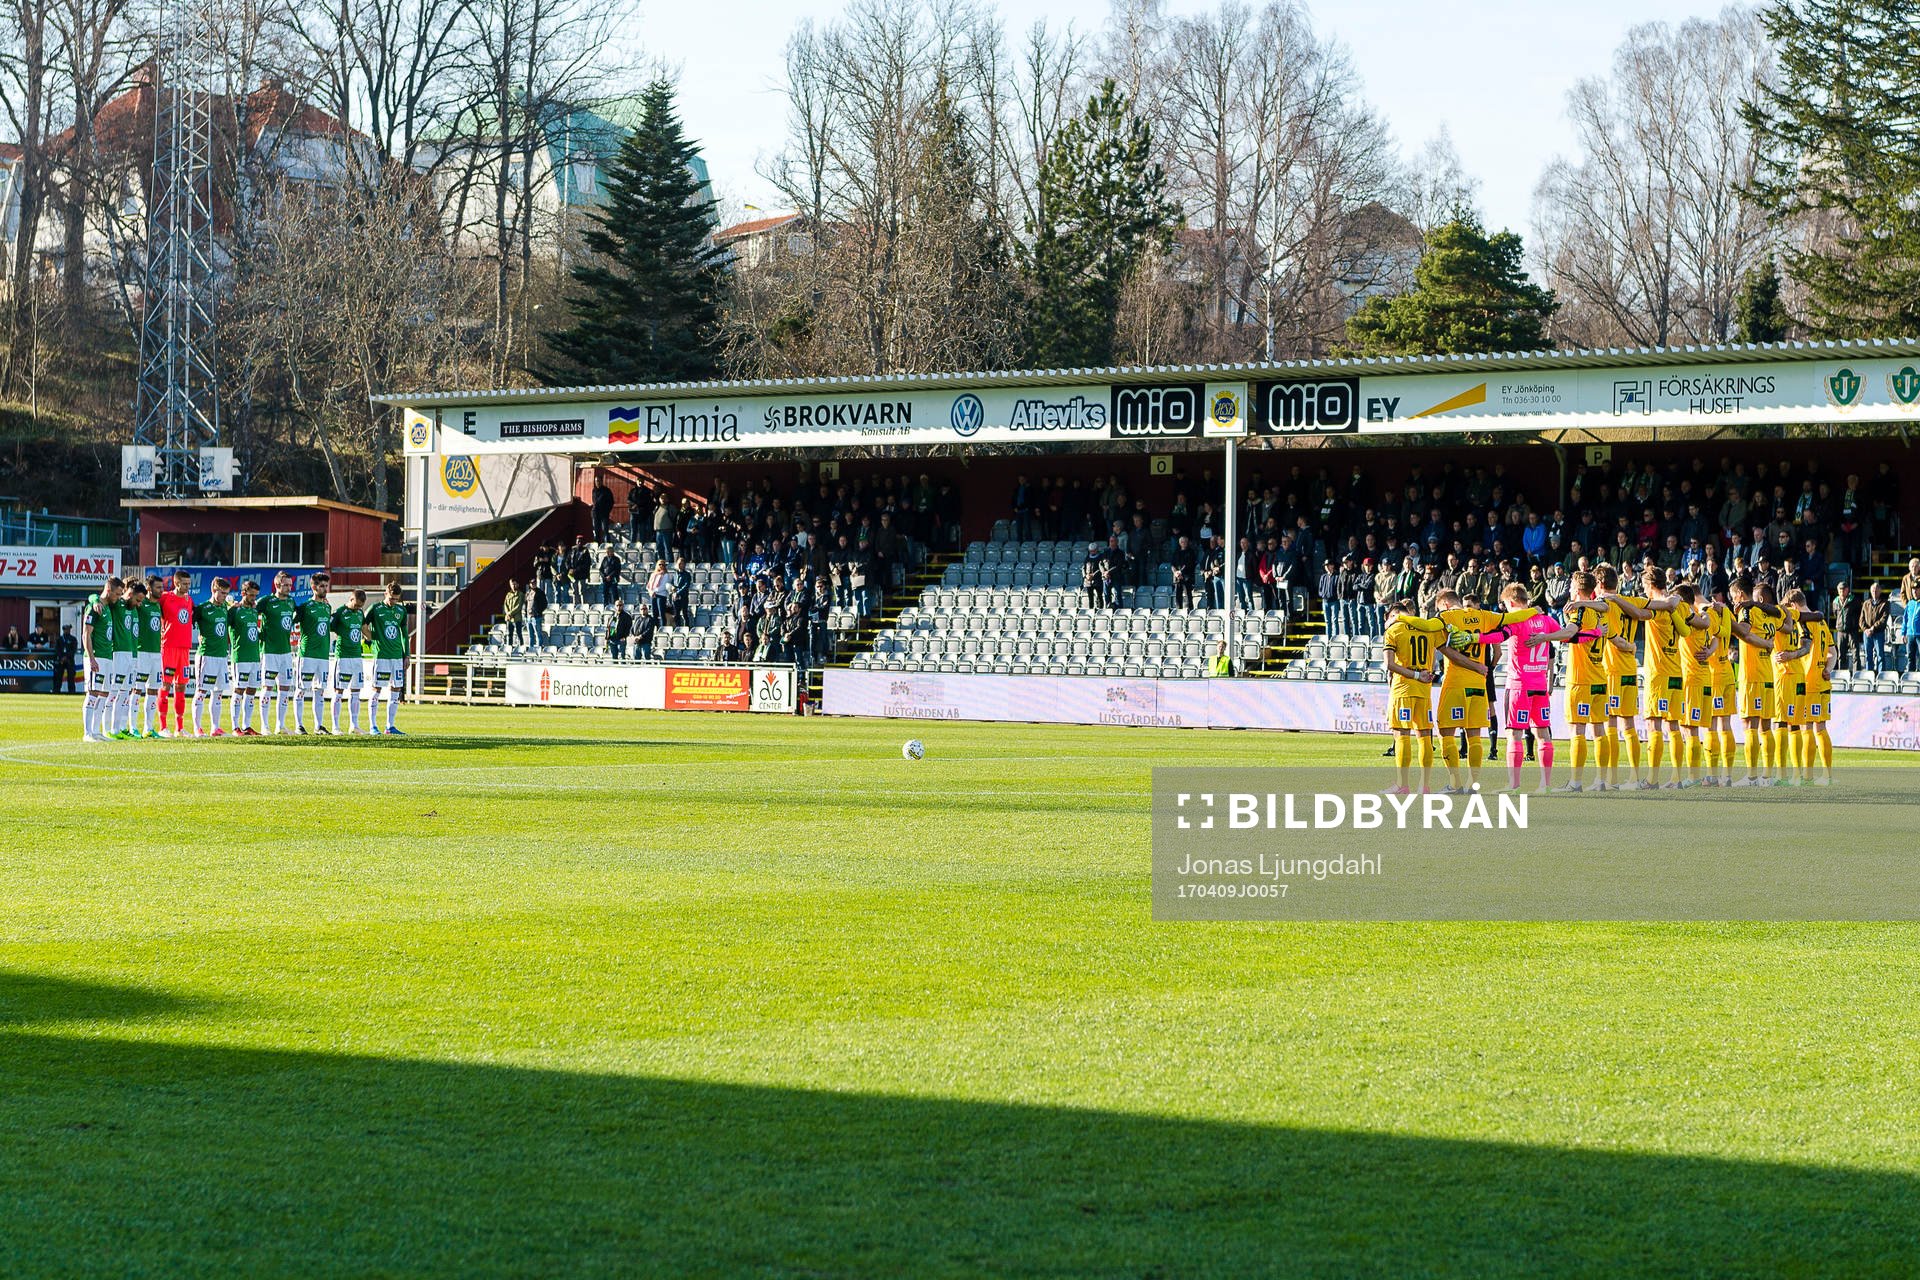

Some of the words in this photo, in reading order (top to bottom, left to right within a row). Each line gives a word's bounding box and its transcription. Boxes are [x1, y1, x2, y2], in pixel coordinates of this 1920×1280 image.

[1502, 385, 1513, 394] EY
[1514, 384, 1555, 395] Jönköping
[1659, 374, 1776, 397] FÖRSÄKRINGS
[1514, 395, 1540, 405] 036-30
[1541, 395, 1551, 404] 10
[1551, 395, 1562, 404] 00
[1689, 396, 1745, 415] HUSET
[784, 402, 912, 428] BROKVARN
[1010, 396, 1106, 431] Atteviks
[1366, 396, 1401, 423] EY
[503, 425, 521, 435] THE
[522, 423, 558, 434] BISHOPS
[559, 422, 583, 433] ARMS
[644, 403, 741, 444] Elmia
[861, 427, 896, 437] Konsult
[898, 427, 911, 436] AB
[1594, 451, 1603, 465] P
[53, 554, 115, 575] MAXI
[1409, 634, 1428, 666] 10
[0, 659, 55, 671] DSSONS
[673, 672, 742, 687] CENTRALA
[553, 680, 629, 698] Brandtornet
[758, 702, 782, 711] CENTER
[883, 704, 945, 719] LUSTGÅRDEN
[947, 707, 960, 719] AB
[1099, 711, 1165, 727] LUSTGÅRDEN
[1167, 714, 1182, 726] AB
